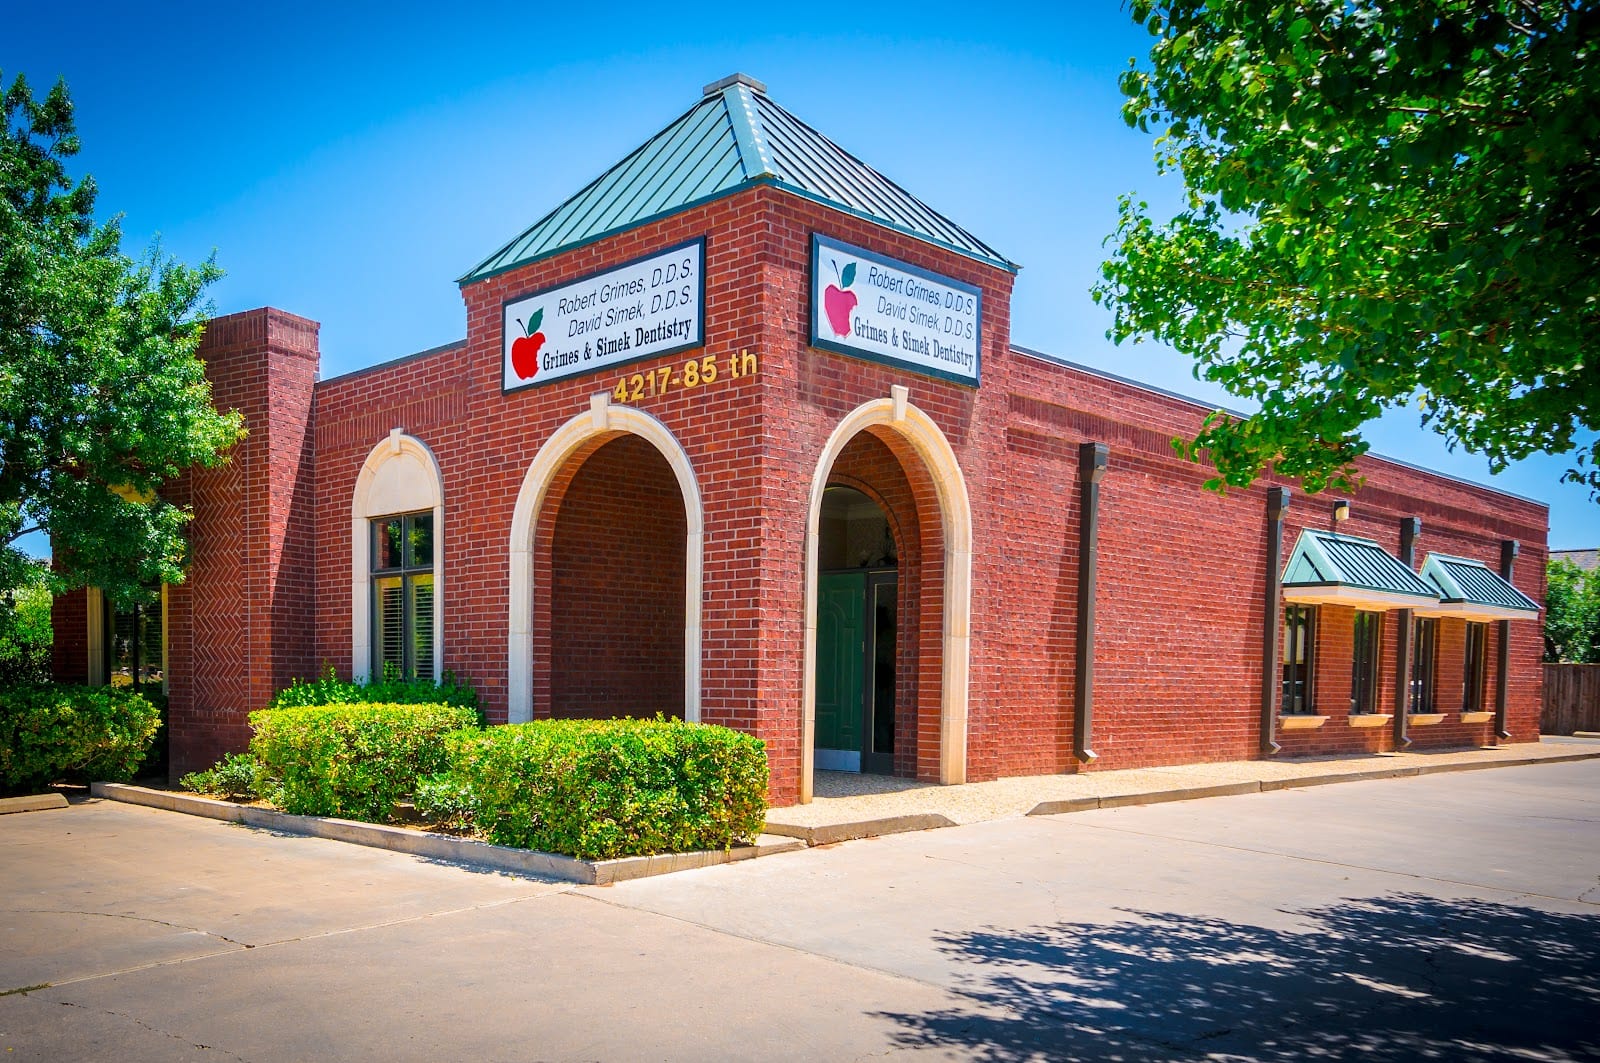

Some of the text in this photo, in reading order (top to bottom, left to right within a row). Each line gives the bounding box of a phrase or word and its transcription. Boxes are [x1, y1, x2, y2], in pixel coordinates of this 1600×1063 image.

[558, 258, 693, 317] Robert Grimes, D.D.S.
[568, 285, 692, 338] David Simek, D.D.S.
[868, 266, 975, 317] Robert Grimes, D.D.S.
[543, 318, 692, 371] Grimes & Simek Dentistry
[854, 316, 974, 373] Grimes & Simek Dentistry
[877, 295, 974, 341] David Simek, D.D.S.
[614, 349, 758, 403] 4217-85 th
